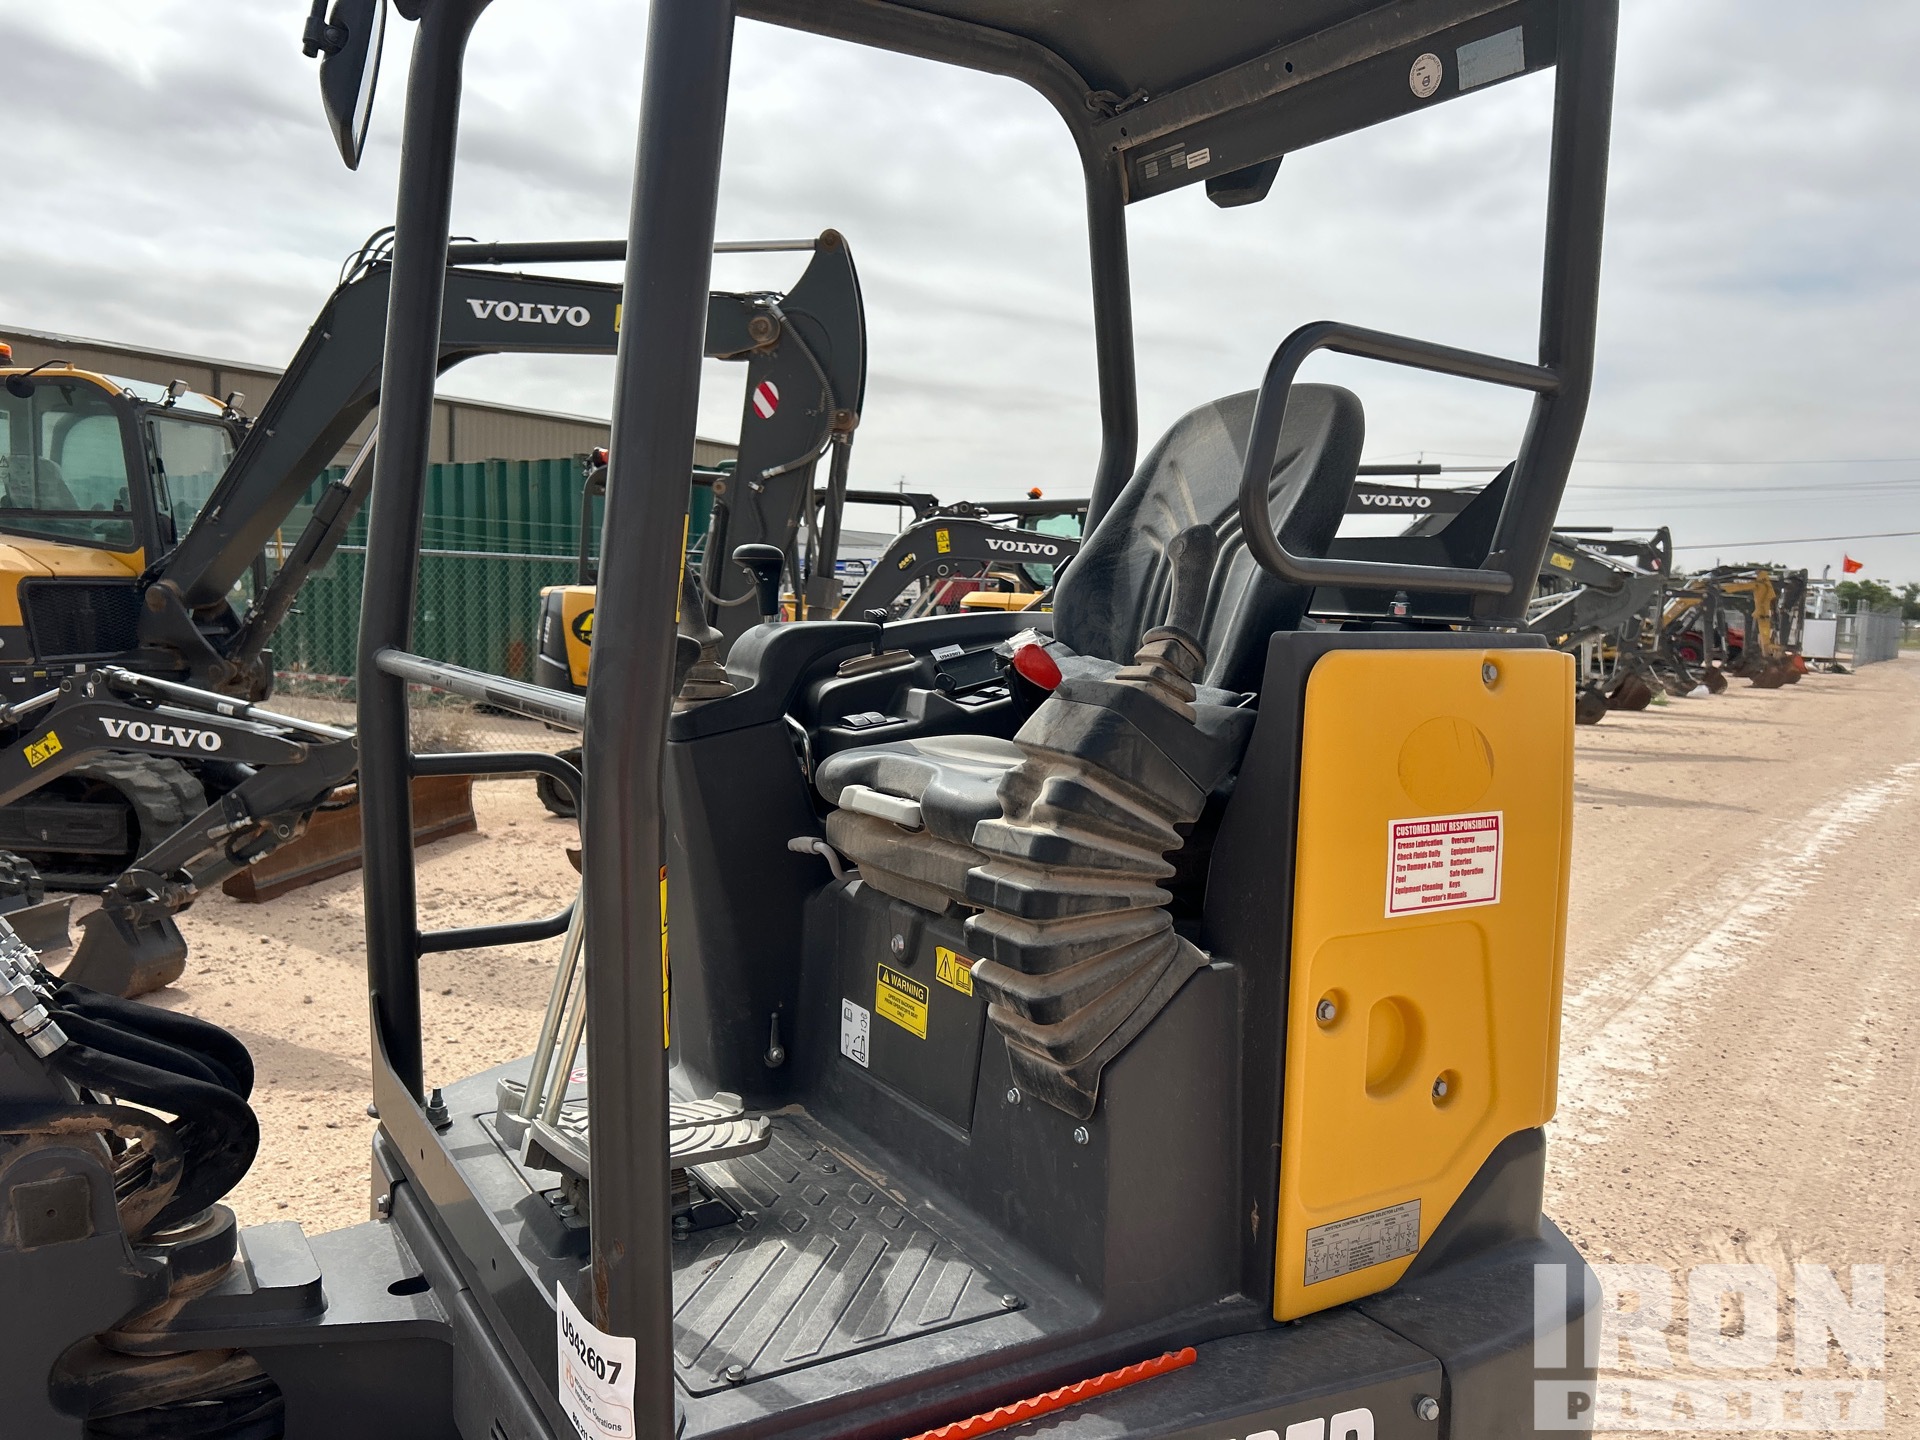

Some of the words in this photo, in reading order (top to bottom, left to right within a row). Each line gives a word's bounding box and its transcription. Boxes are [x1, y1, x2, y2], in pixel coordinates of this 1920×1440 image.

[466, 298, 591, 327] VOLVO
[1357, 493, 1431, 508] VOLVO
[985, 538, 1058, 556] VOLVO
[99, 717, 222, 751] VOLVO
[1396, 824, 1430, 836] CUSTOMER
[1431, 822, 1448, 833] DAILY
[1448, 818, 1497, 831] RESPONSIBILITY
[1398, 841, 1415, 849] Grease
[1415, 839, 1443, 848] Lubrication
[1451, 836, 1475, 844] Overspray
[1397, 853, 1412, 861] Check
[1413, 851, 1427, 859] Fluids
[1428, 850, 1441, 858] Daily
[1451, 846, 1475, 856] Equipment
[1476, 845, 1495, 853] Damage
[1396, 864, 1406, 872] Tire
[1407, 863, 1427, 871] Damage
[1450, 858, 1472, 866] Batteries
[1461, 867, 1484, 877] Operation
[1396, 875, 1406, 883] Fuel
[1395, 885, 1421, 895] Equipment
[1422, 883, 1443, 891] Cleaning
[1449, 881, 1461, 889] Keys
[1421, 894, 1446, 904] Operator's
[1447, 891, 1467, 900] Manuals
[891, 973, 924, 1001] WARNING
[561, 1310, 622, 1385] U942607
